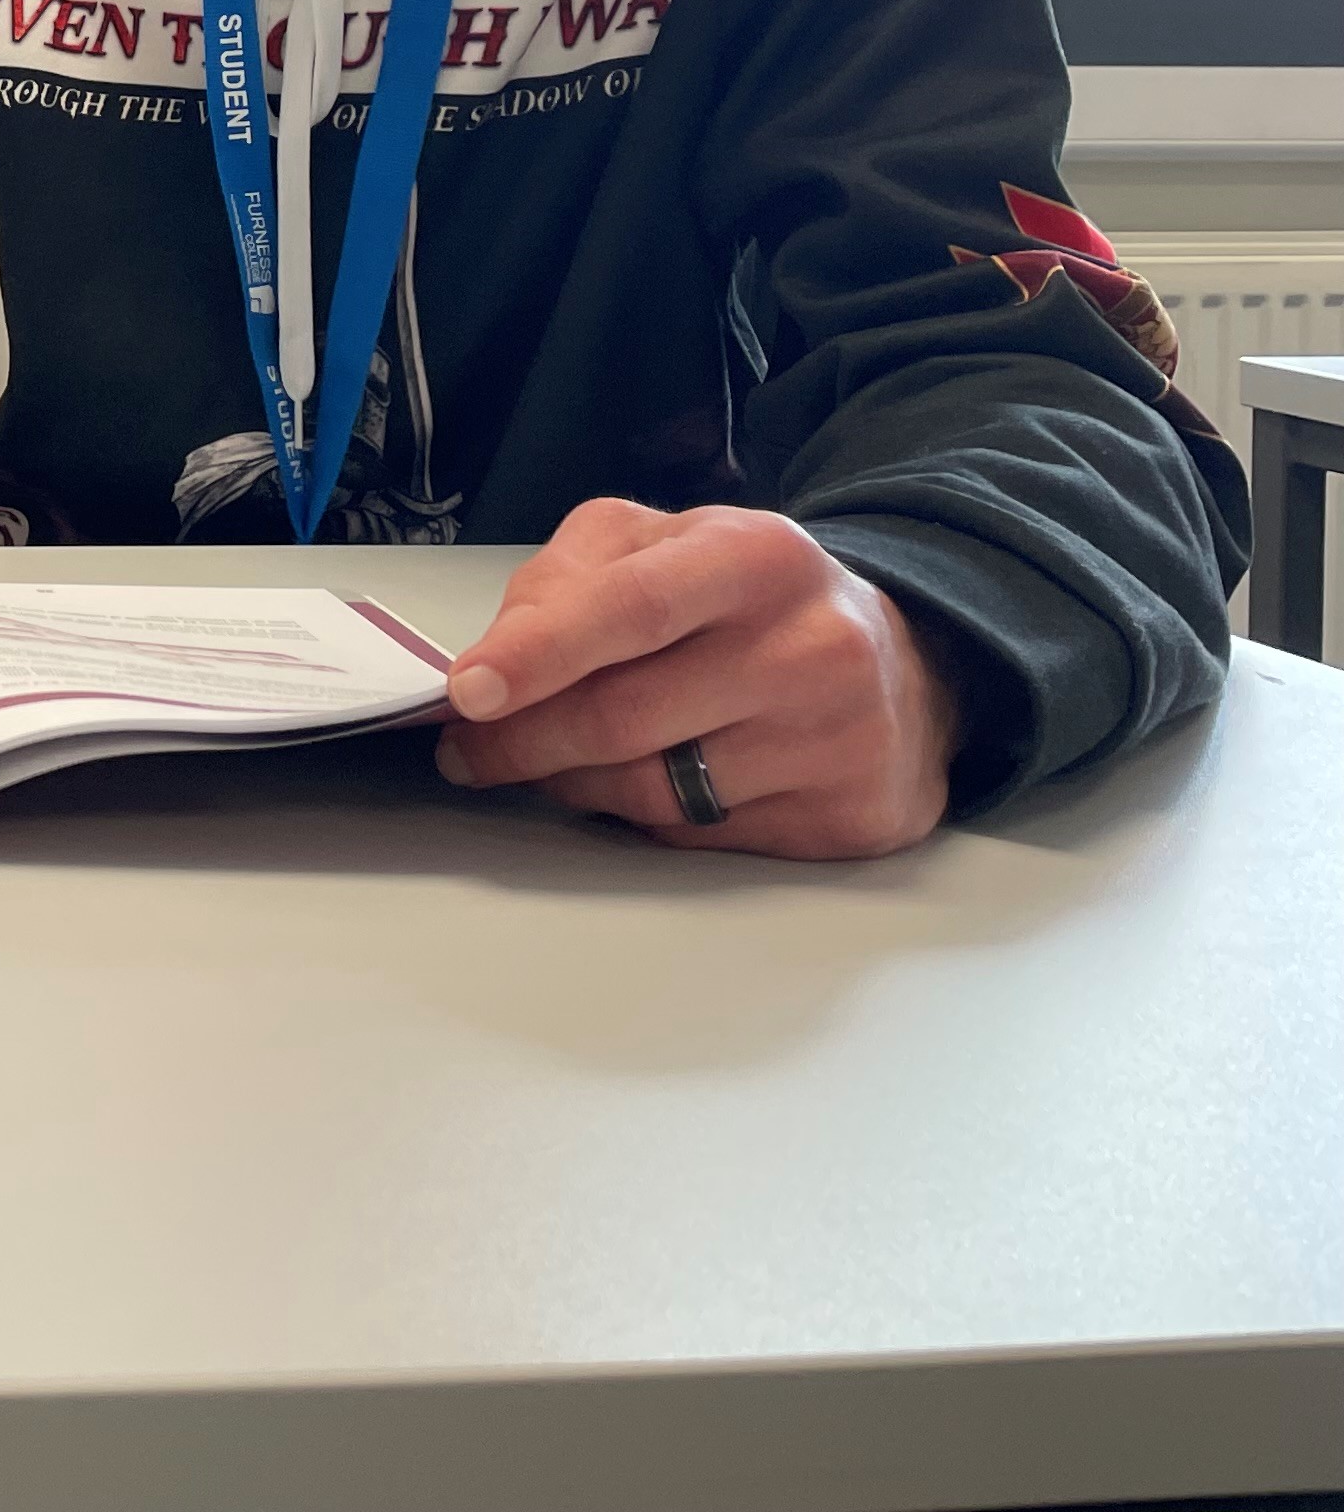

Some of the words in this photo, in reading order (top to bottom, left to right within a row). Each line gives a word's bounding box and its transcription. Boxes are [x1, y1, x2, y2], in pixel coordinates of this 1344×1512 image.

[119, 95, 185, 123] THE
[218, 13, 252, 145] STUDENT
[244, 191, 272, 283] FURNESS
